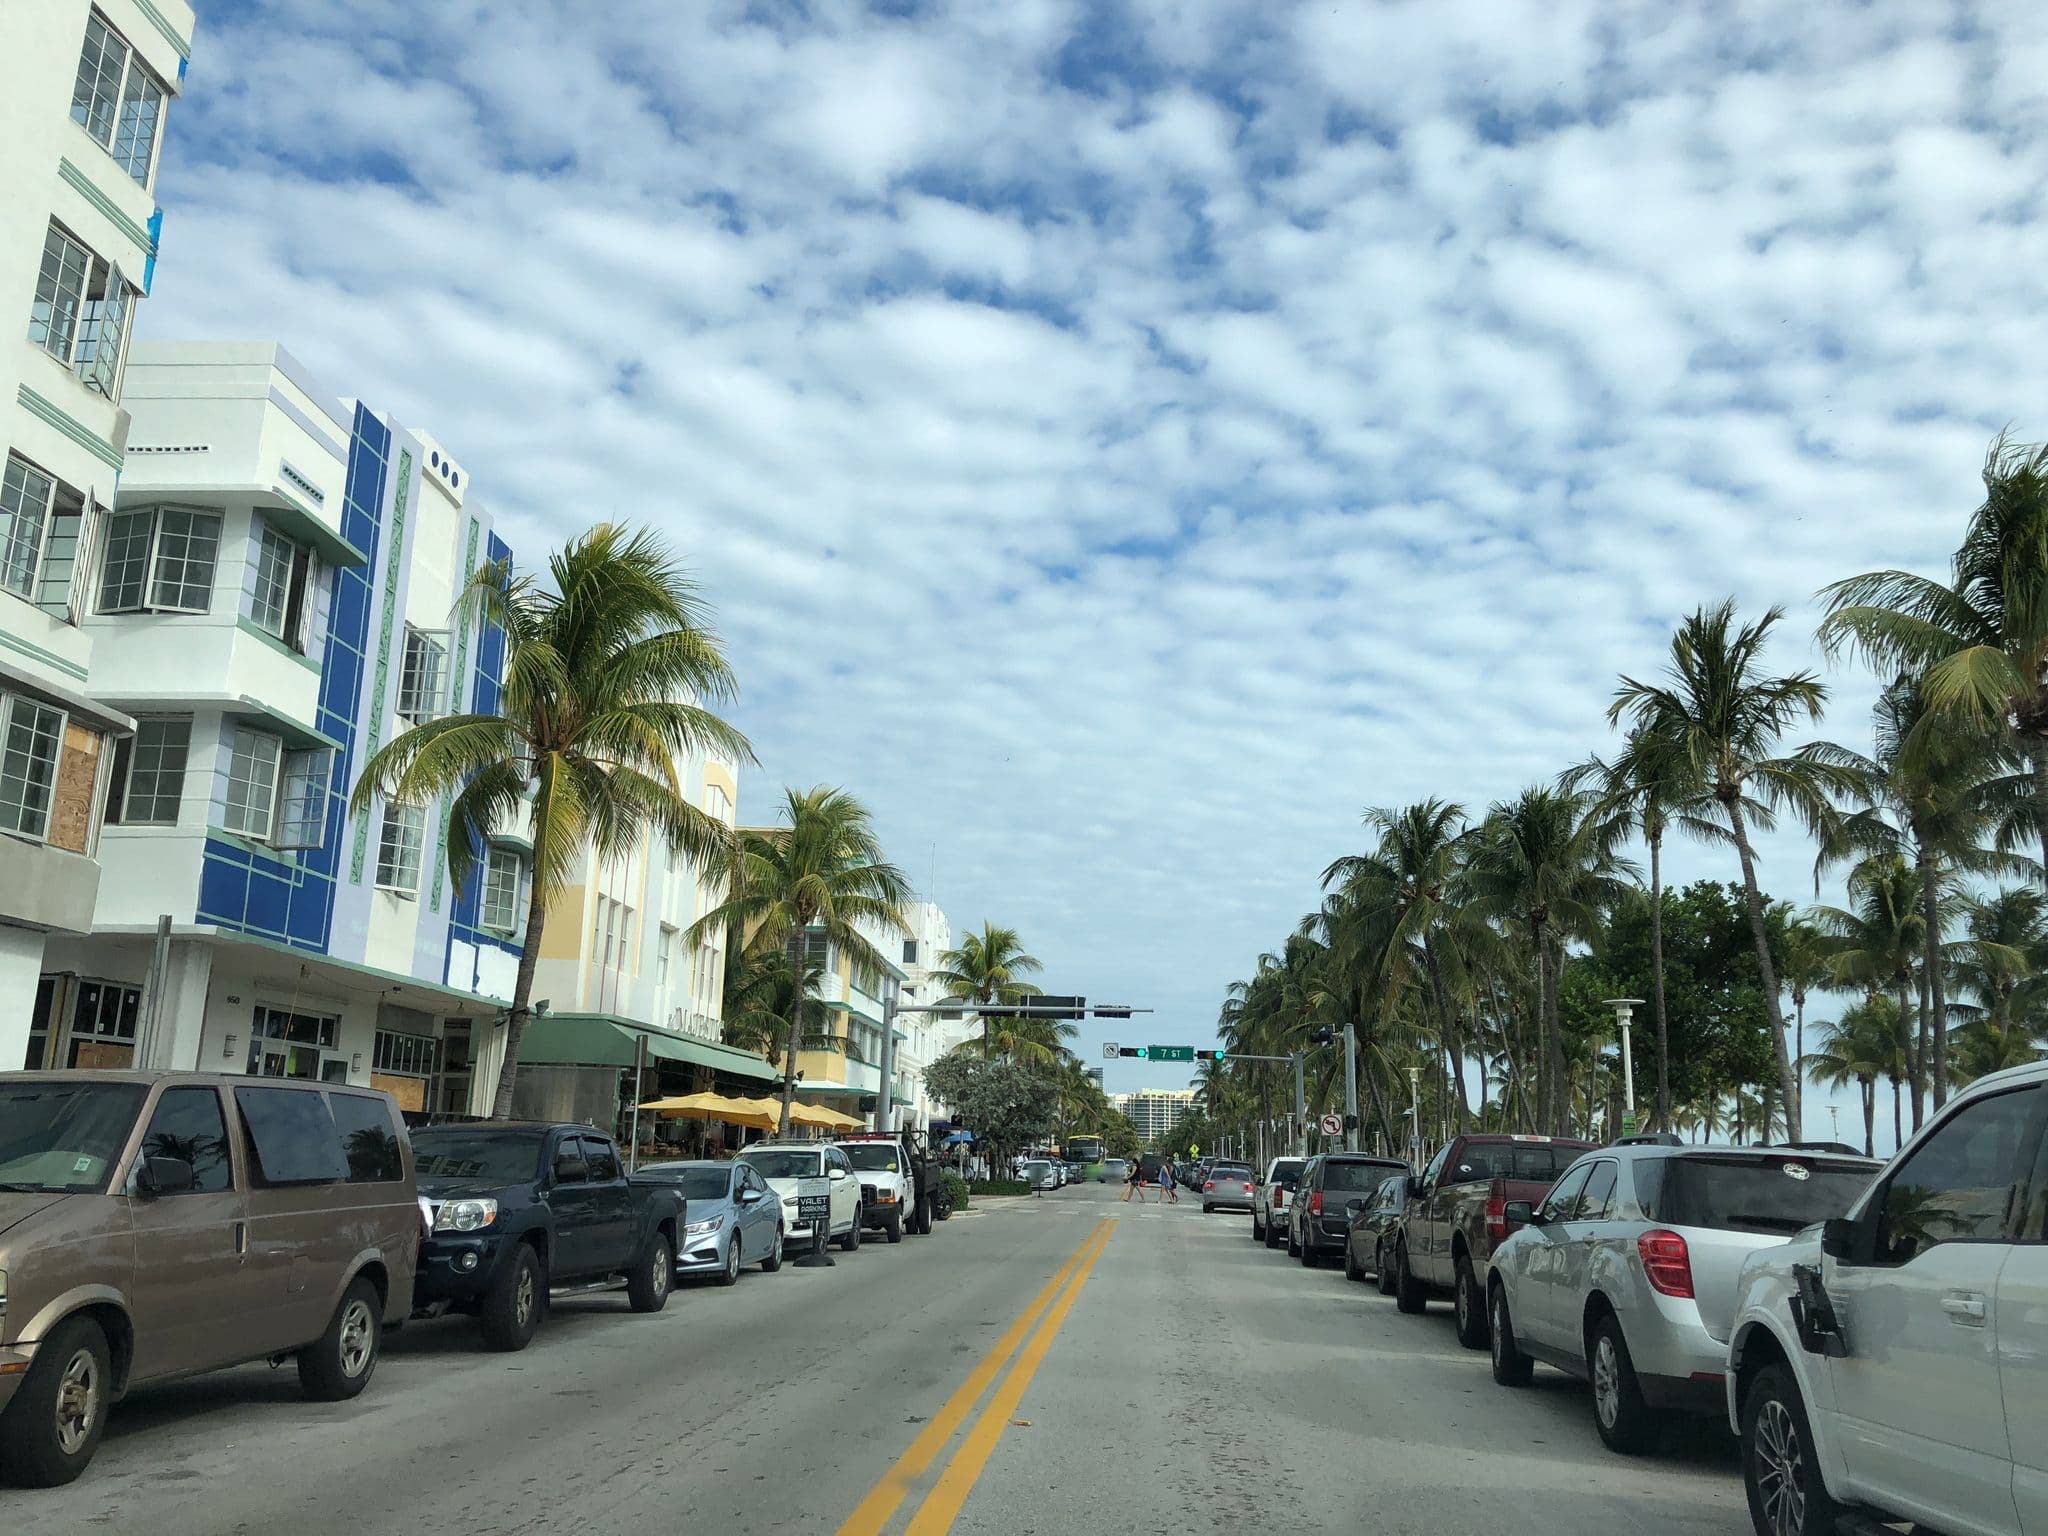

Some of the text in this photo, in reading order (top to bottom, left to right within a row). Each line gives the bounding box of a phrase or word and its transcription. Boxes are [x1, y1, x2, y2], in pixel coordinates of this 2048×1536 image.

[1161, 1048, 1181, 1058] 7 ST
[800, 1196, 828, 1206] VALET
[800, 1204, 828, 1213] PARKING
